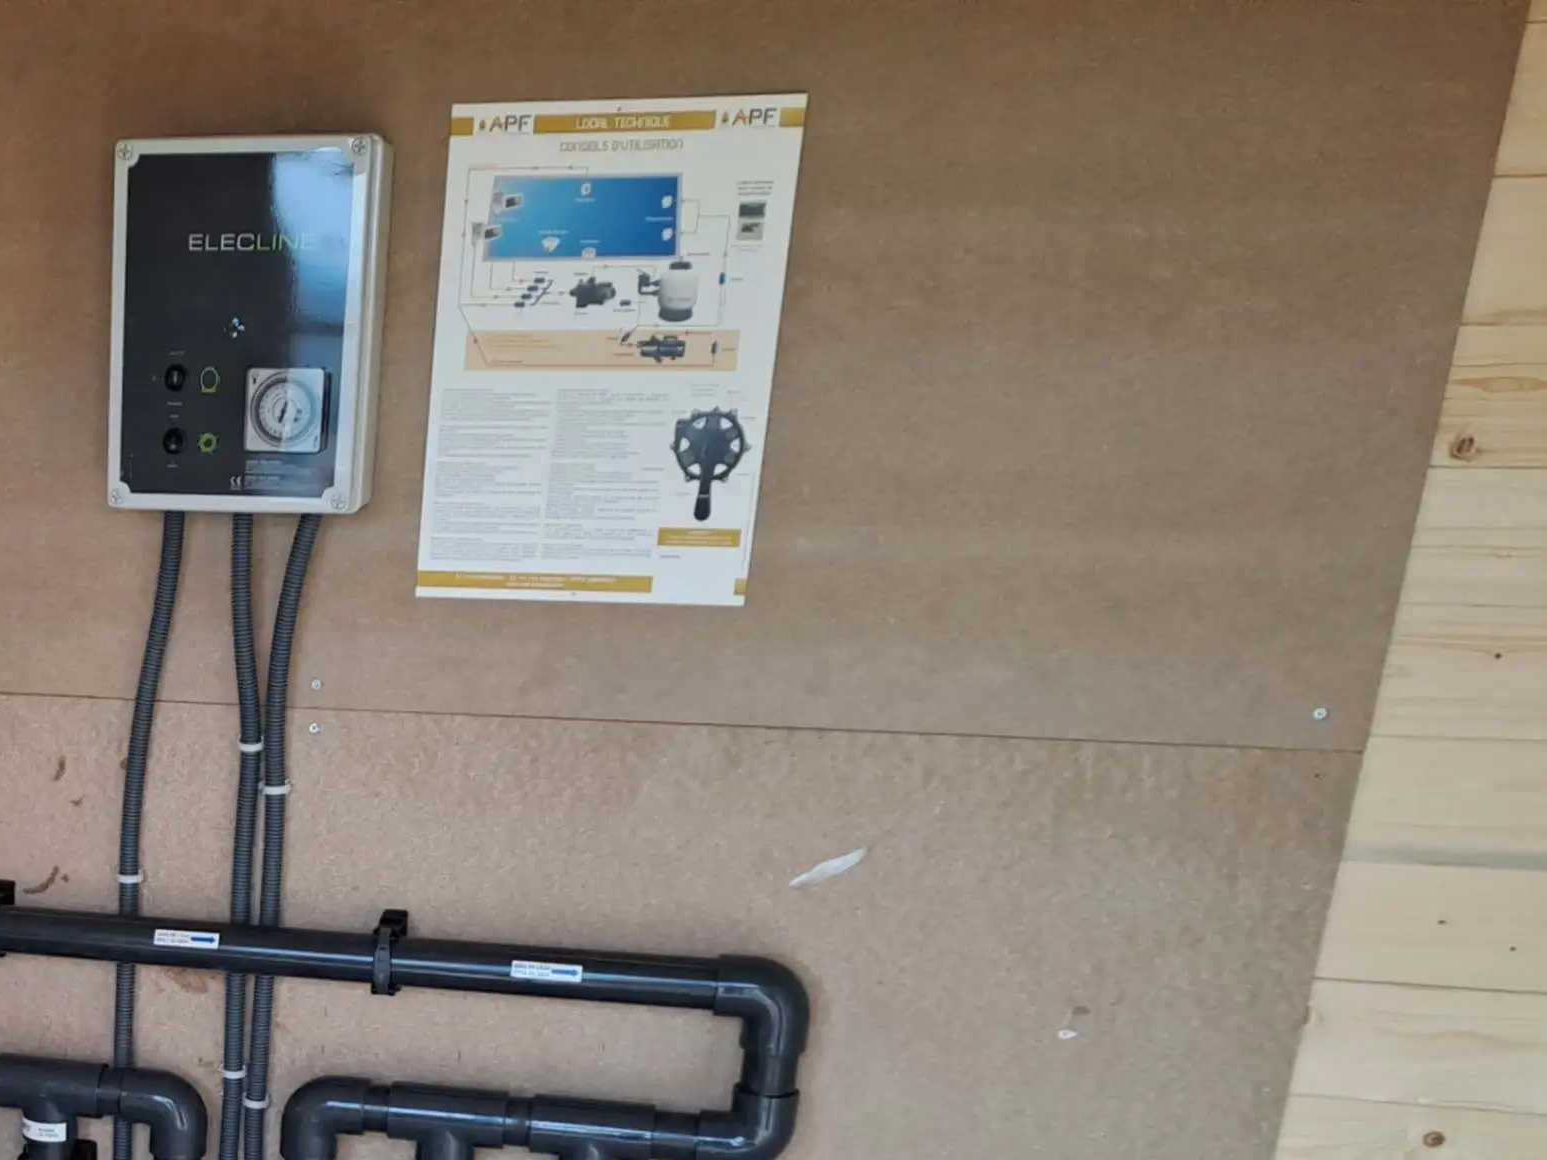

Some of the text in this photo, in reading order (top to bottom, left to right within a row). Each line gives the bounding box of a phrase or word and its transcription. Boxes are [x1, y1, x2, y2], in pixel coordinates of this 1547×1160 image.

[489, 114, 532, 132] APF
[732, 107, 778, 125] APF
[188, 232, 316, 251] ELECLINE
